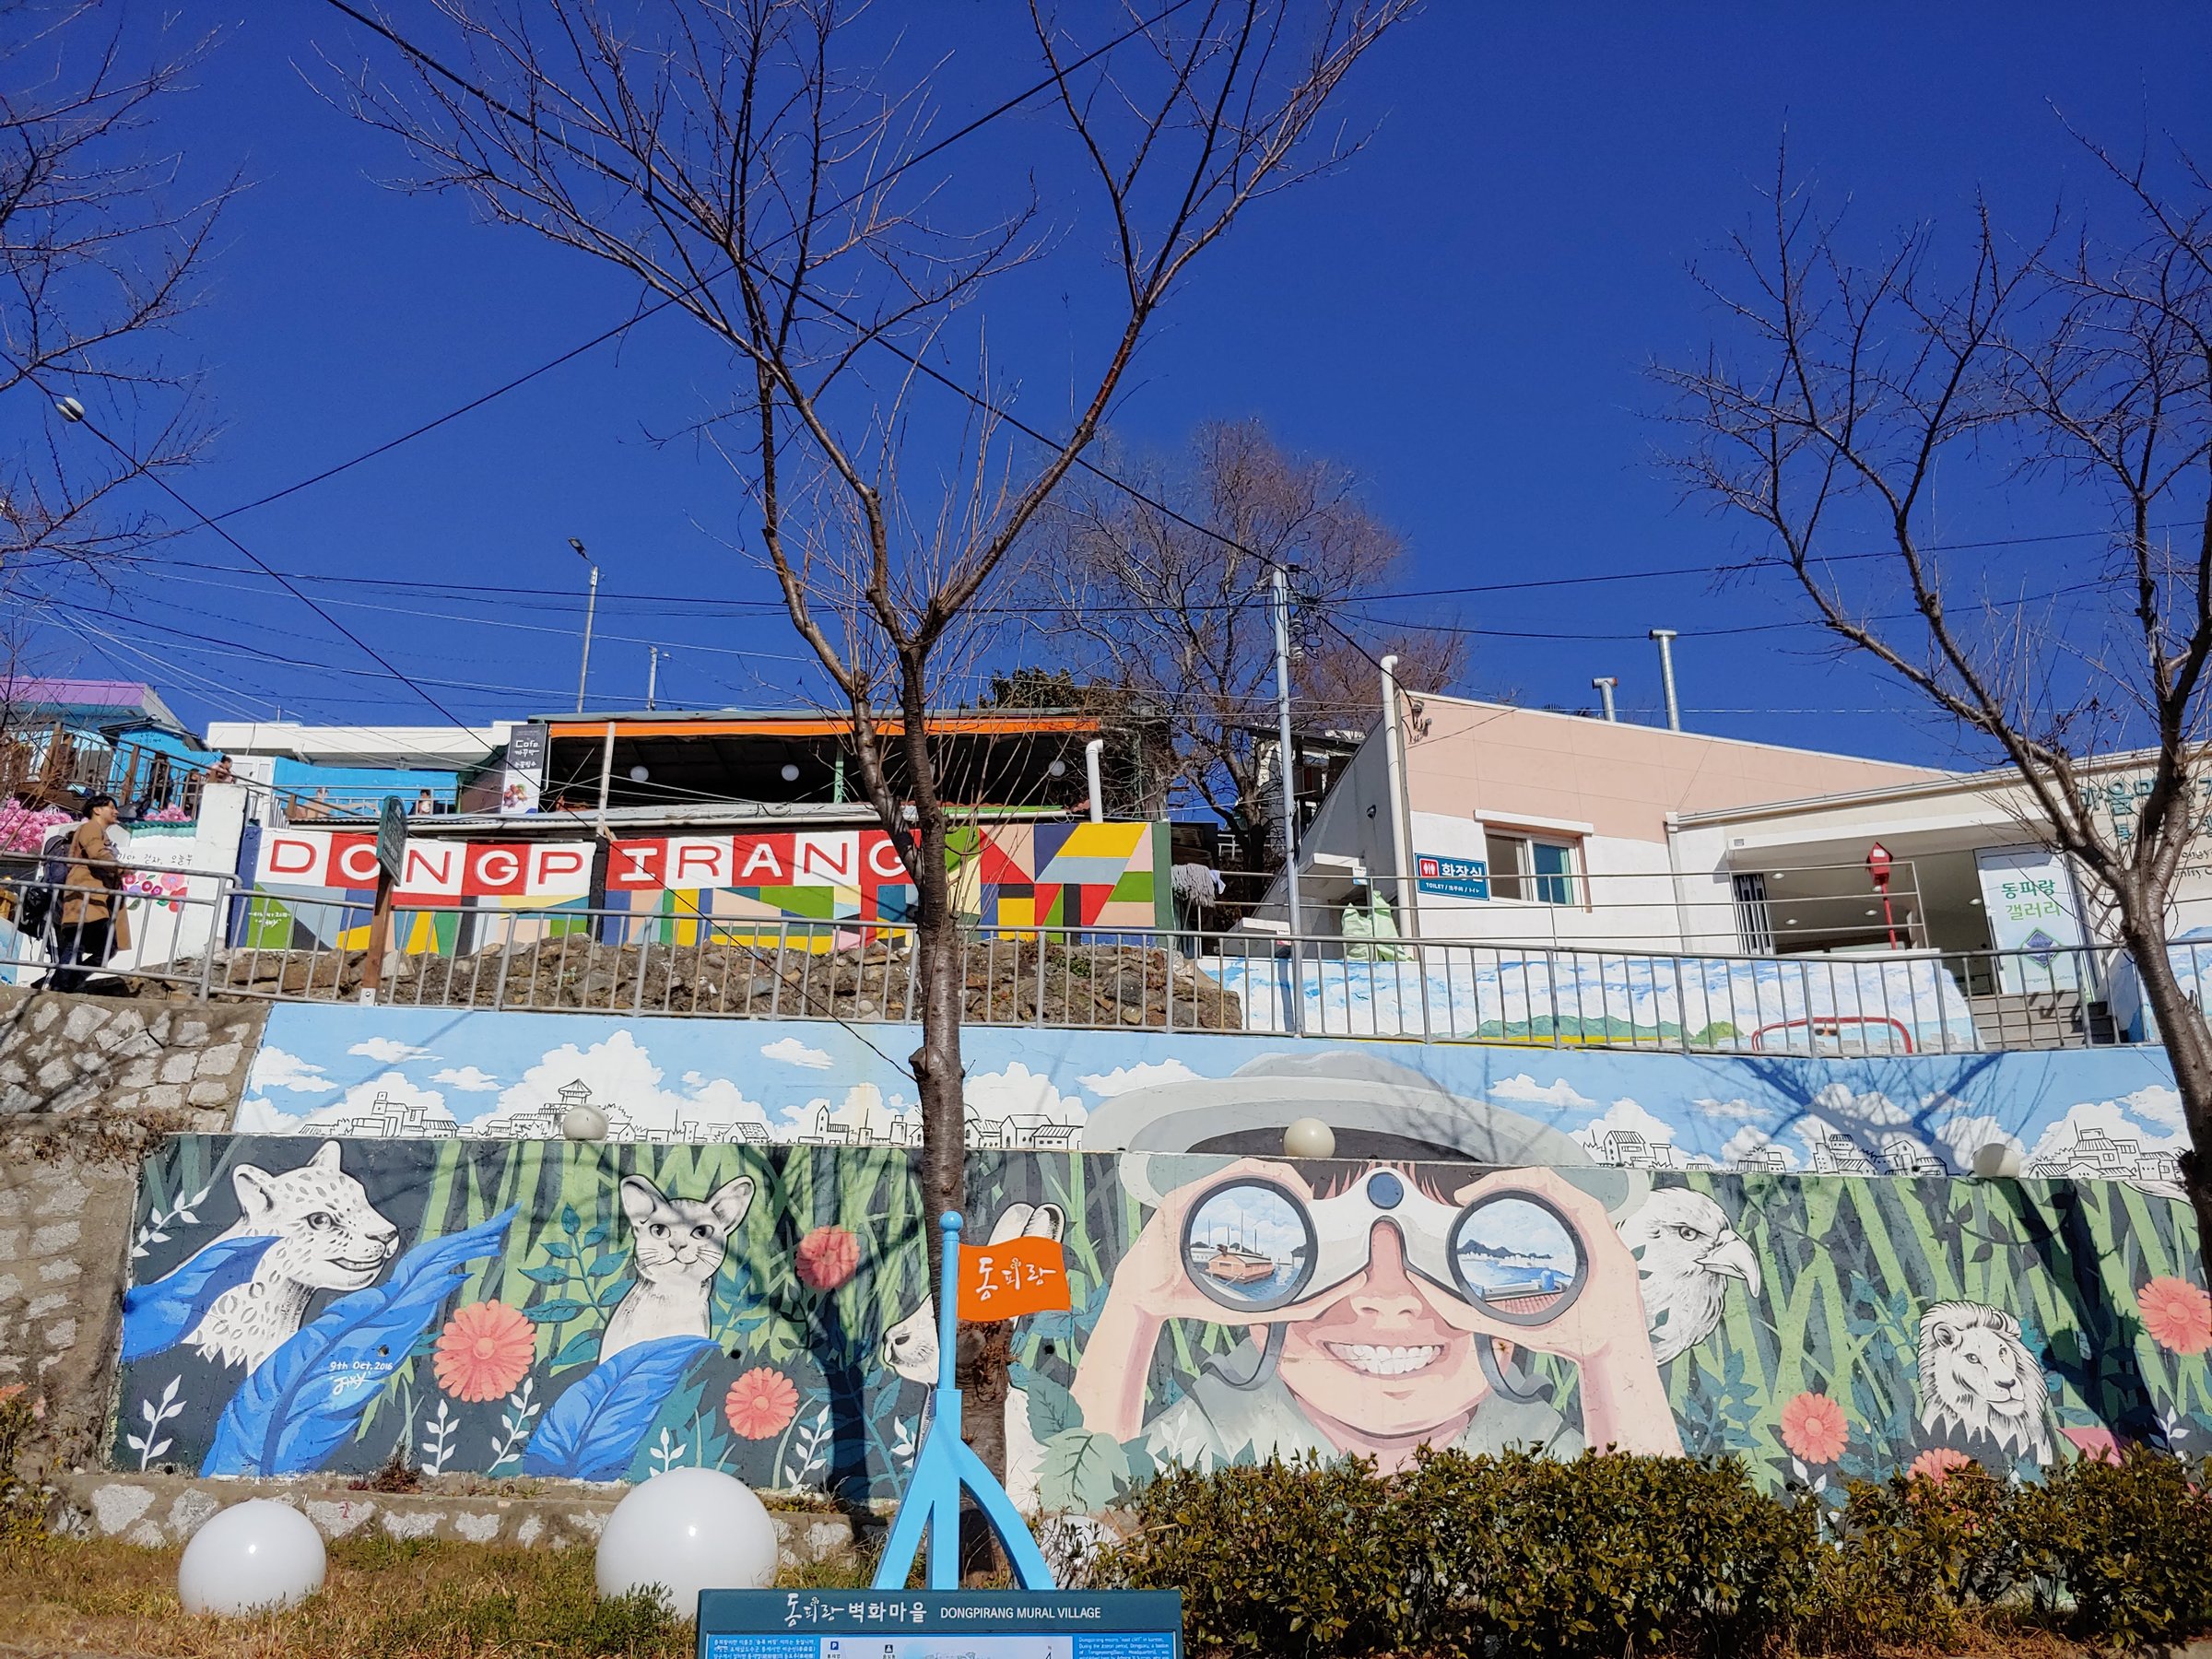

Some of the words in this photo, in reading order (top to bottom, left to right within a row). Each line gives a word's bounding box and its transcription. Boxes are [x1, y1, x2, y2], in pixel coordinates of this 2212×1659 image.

[269, 838, 908, 888] DONGPIRANG
[1441, 863, 1484, 882] 화장실
[1425, 882, 1444, 890] TOILET
[2001, 878, 2056, 900] 동피랑
[2005, 901, 2061, 921] 갤러리
[975, 1256, 1057, 1301] 동피랑
[330, 1360, 348, 1371] 9th
[784, 1593, 845, 1628] 동피랑
[848, 1601, 927, 1624] 벽화마을
[940, 1606, 1014, 1619] DONGPIRANG
[1017, 1606, 1056, 1619] MURAL
[1056, 1606, 1101, 1619] VILLAGE
